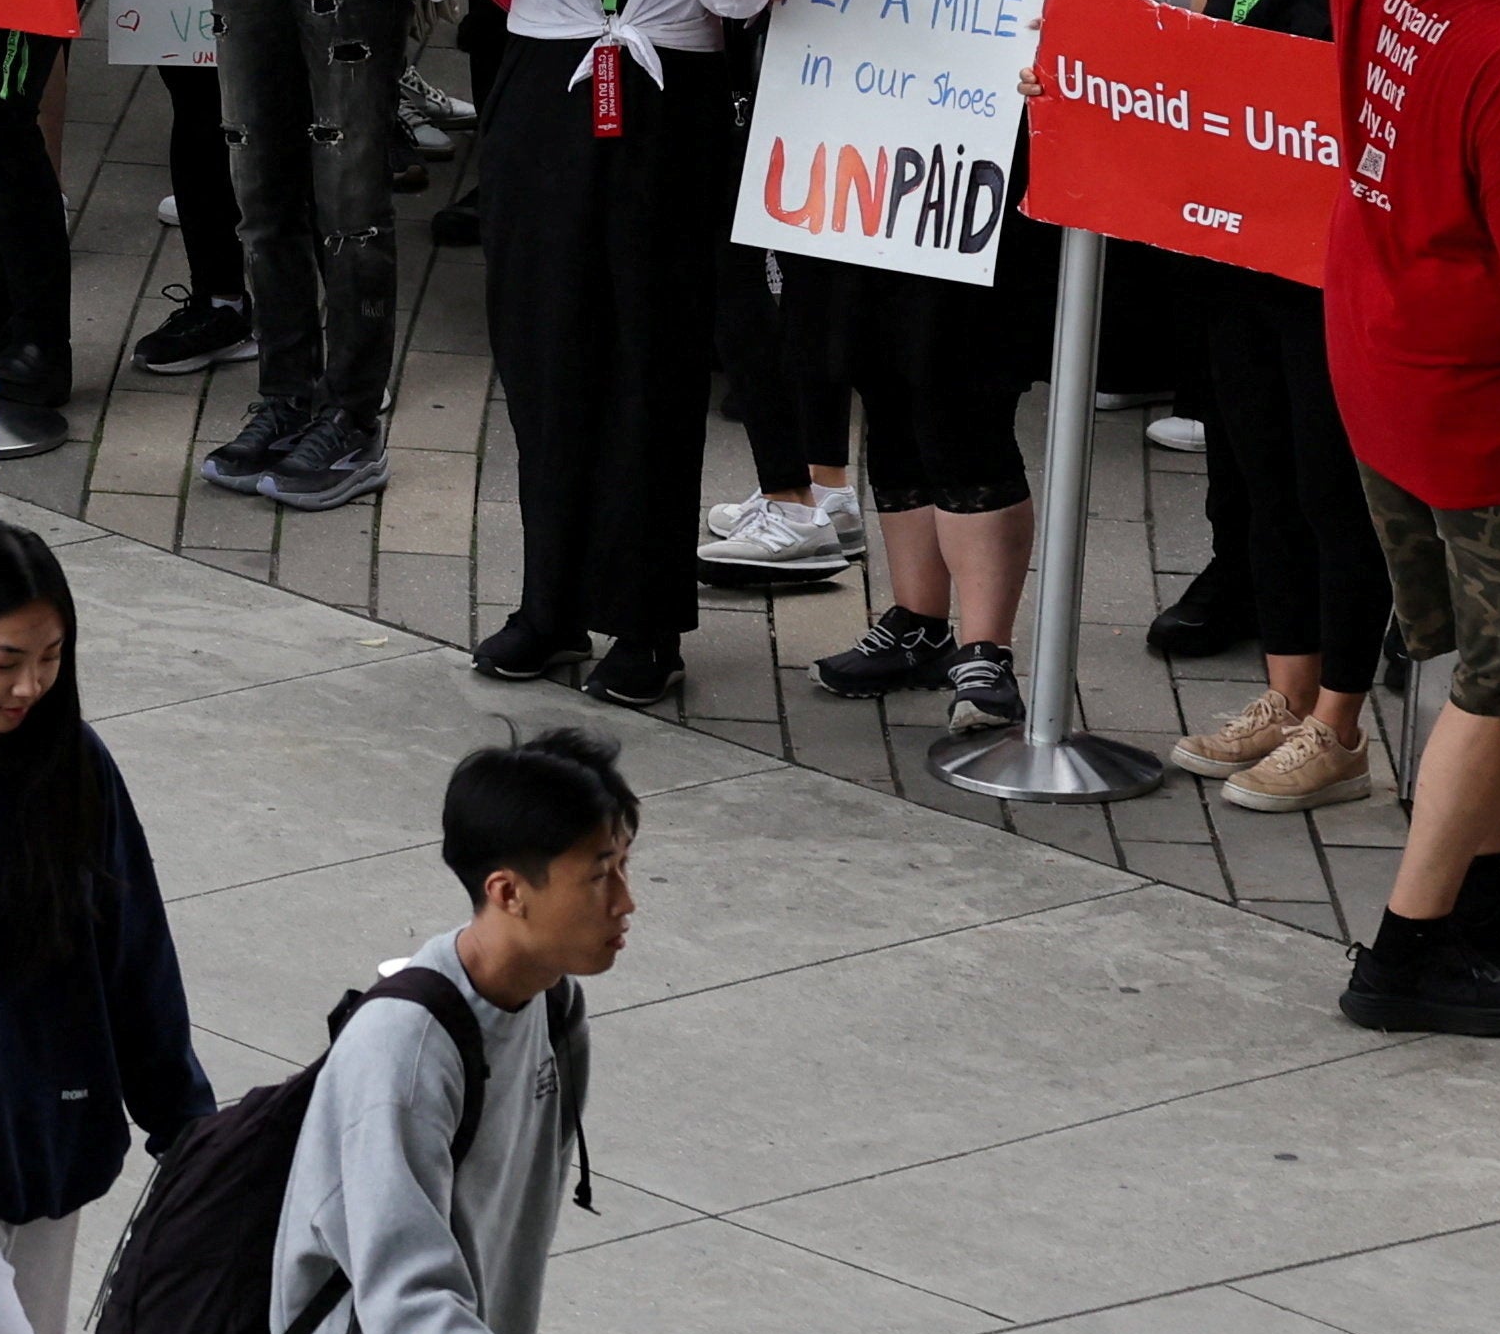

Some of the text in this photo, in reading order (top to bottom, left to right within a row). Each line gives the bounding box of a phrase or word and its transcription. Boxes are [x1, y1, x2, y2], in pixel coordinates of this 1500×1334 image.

[801, 44, 916, 101] in our
[1057, 54, 1189, 131] Unpaid
[1203, 111, 1230, 138] =
[1182, 201, 1243, 234] CUPE
